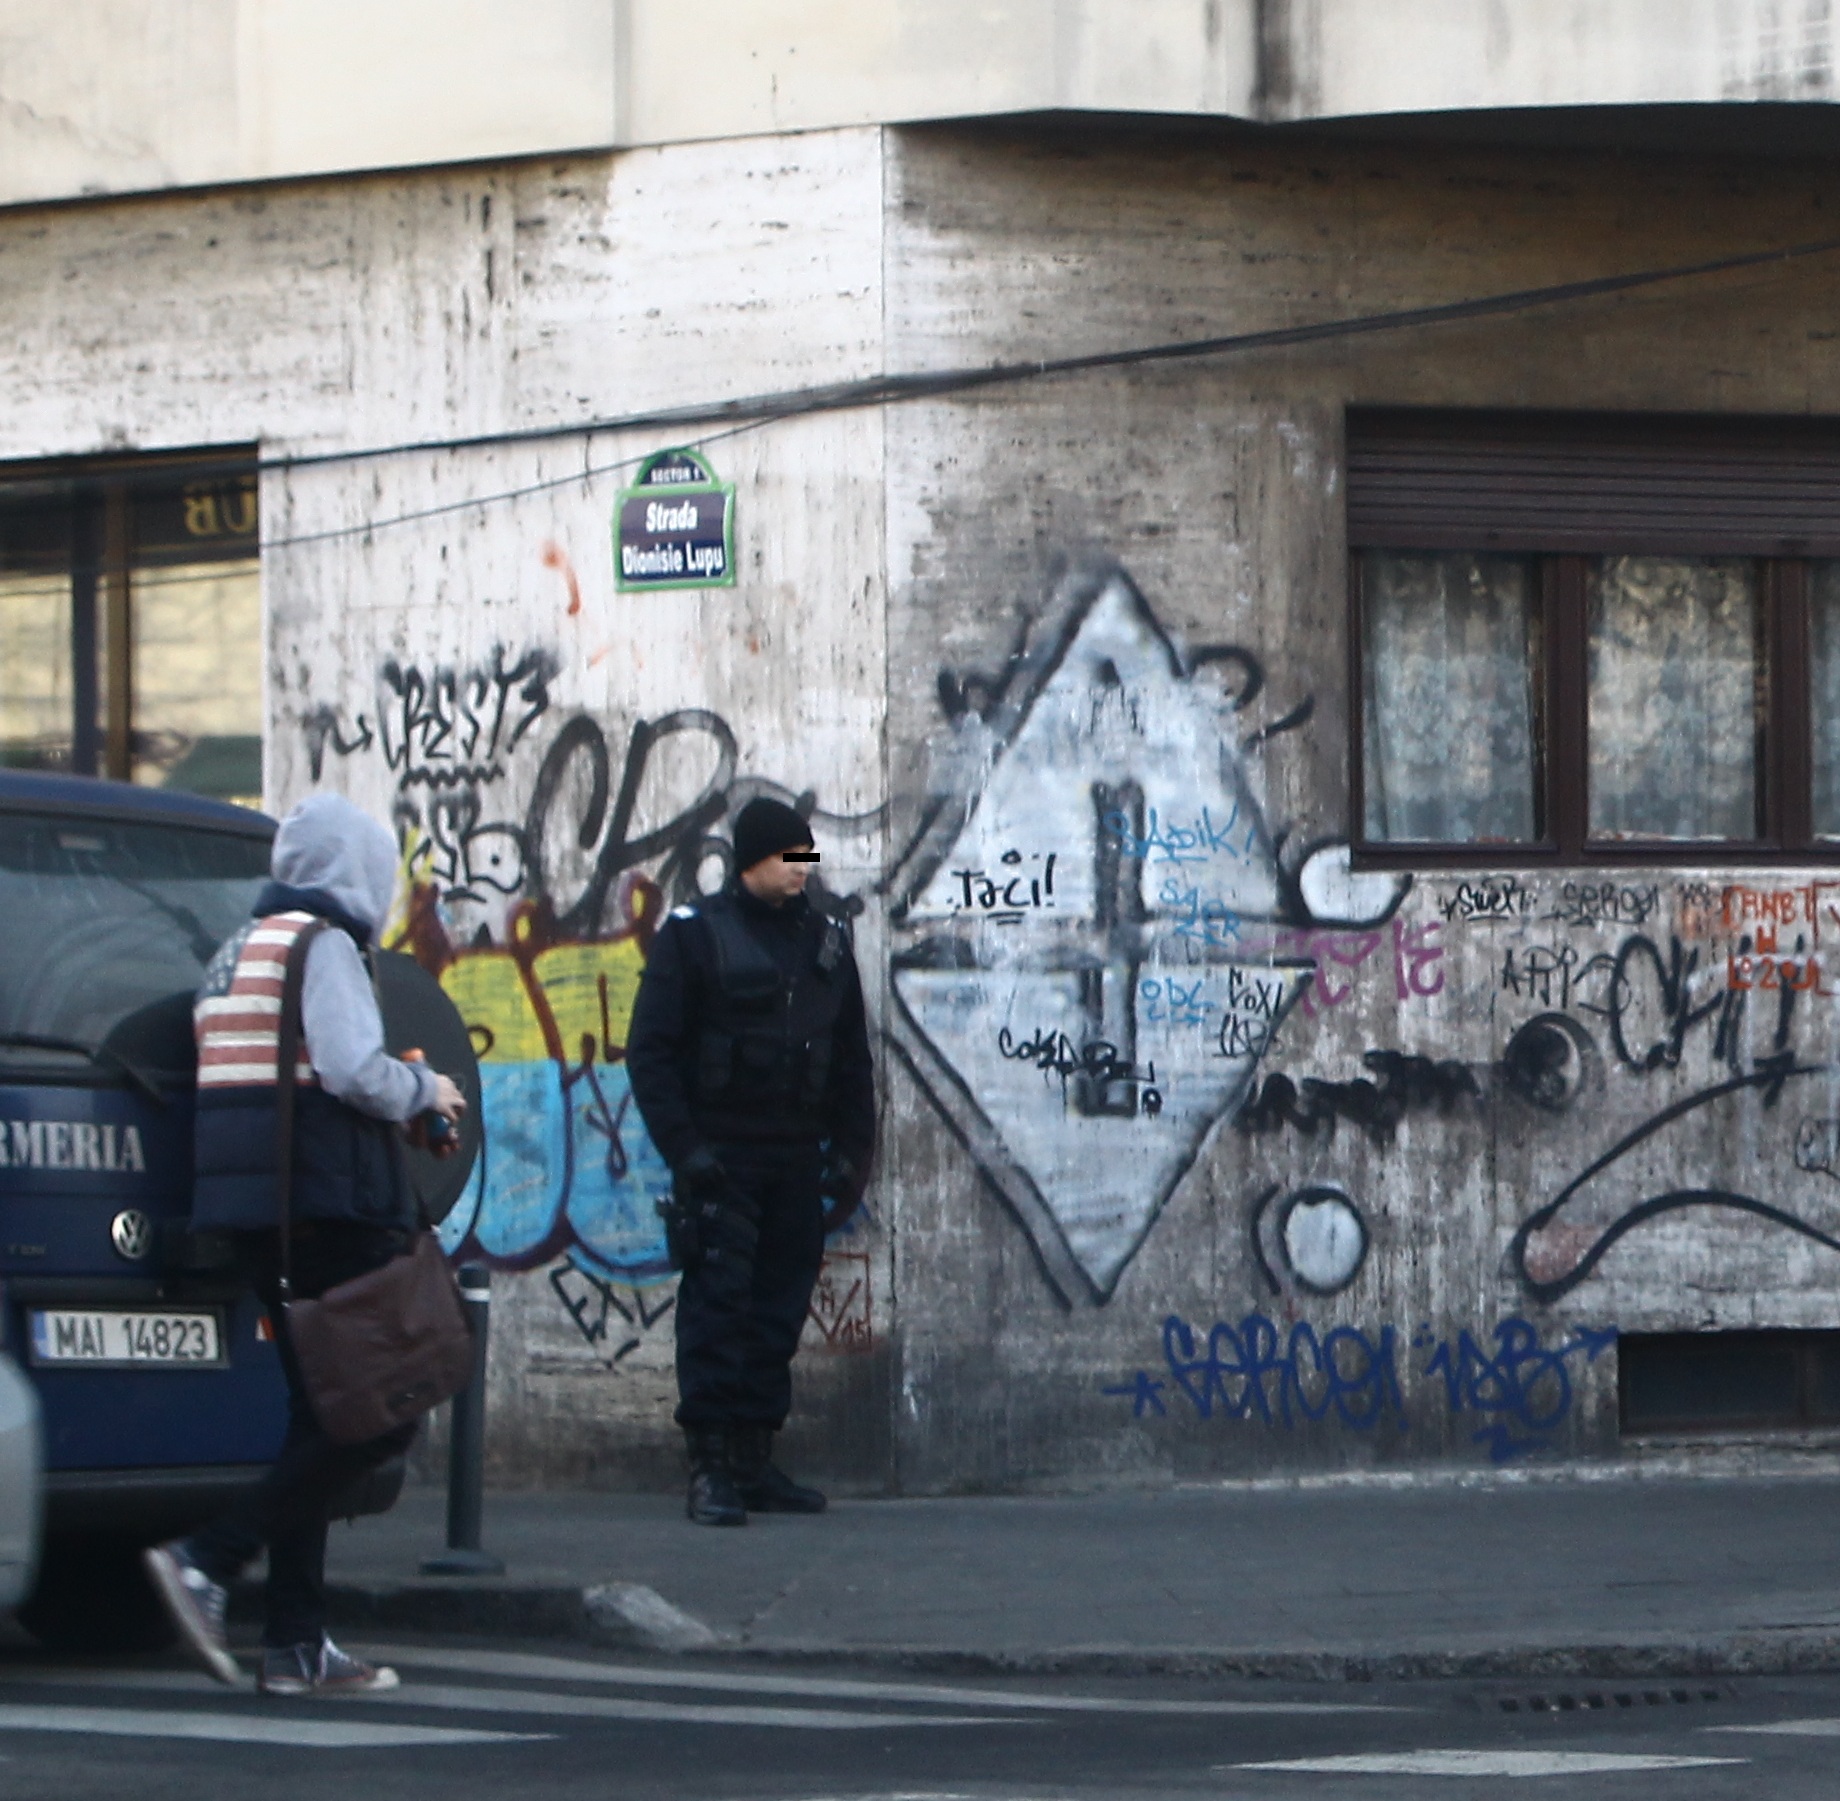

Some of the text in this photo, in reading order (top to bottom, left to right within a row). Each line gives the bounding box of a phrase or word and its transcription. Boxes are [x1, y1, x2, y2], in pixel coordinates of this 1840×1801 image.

[651, 467, 692, 483] SECTOR
[645, 500, 699, 533] Strada
[622, 541, 723, 577] Dionisie Lupu
[55, 1316, 207, 1360] MAI 14823
